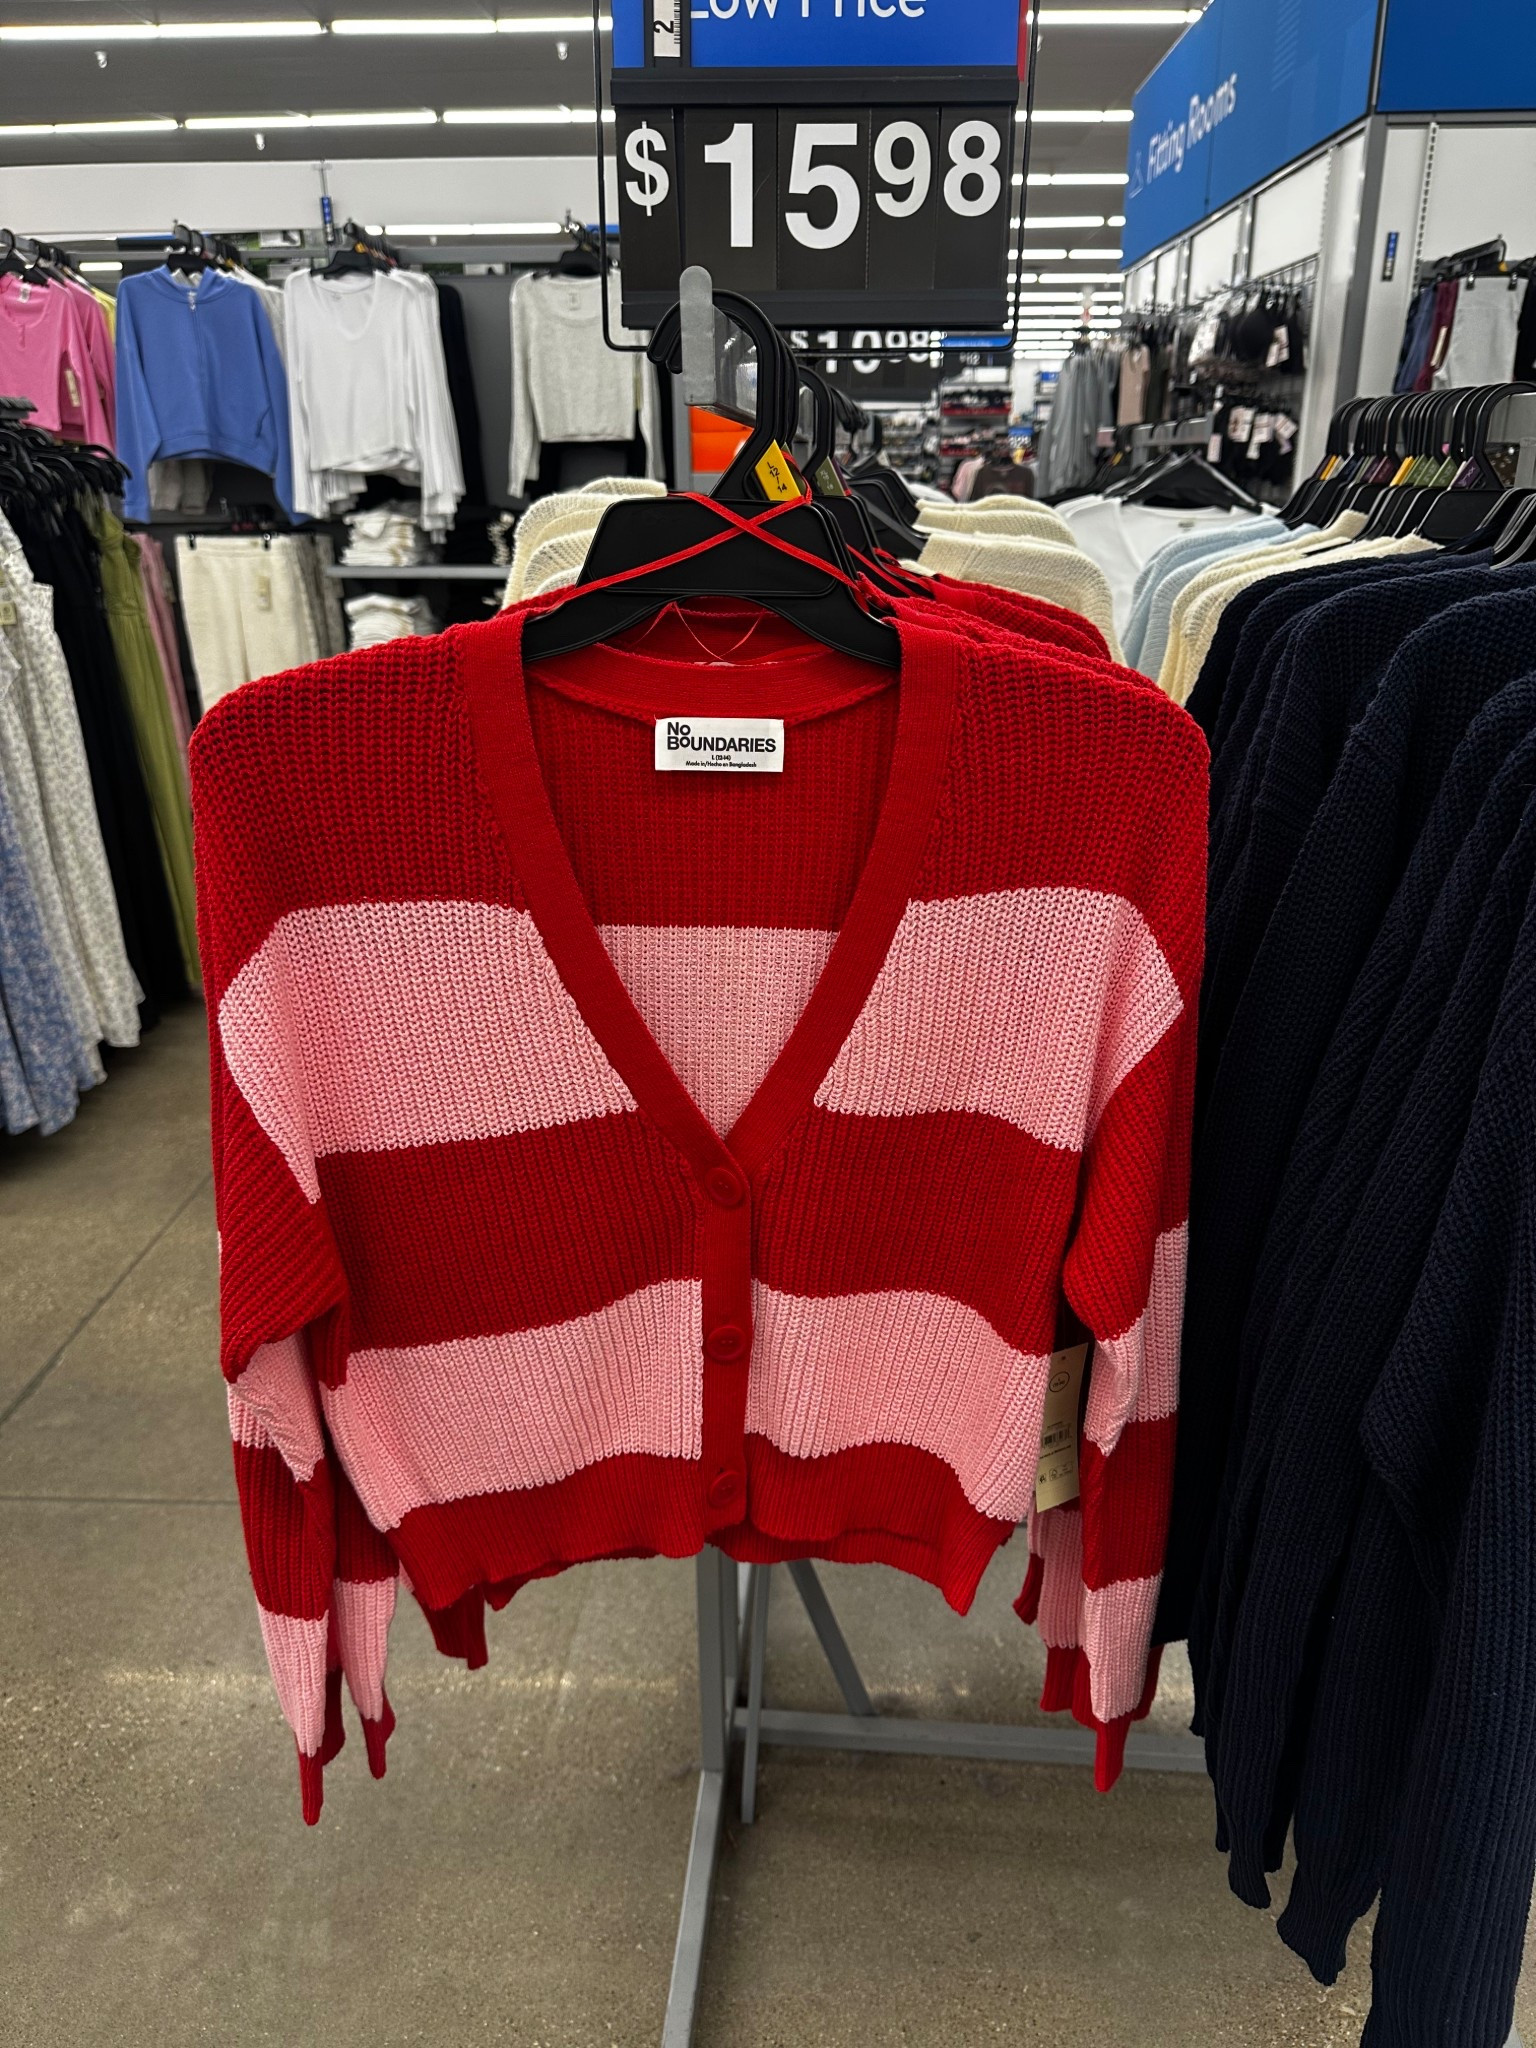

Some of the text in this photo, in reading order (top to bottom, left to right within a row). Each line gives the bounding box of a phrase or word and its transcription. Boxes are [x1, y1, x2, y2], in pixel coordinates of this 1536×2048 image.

[1146, 73, 1238, 184] Fitting Rooms
[729, 761, 757, 769] Bangladesh
